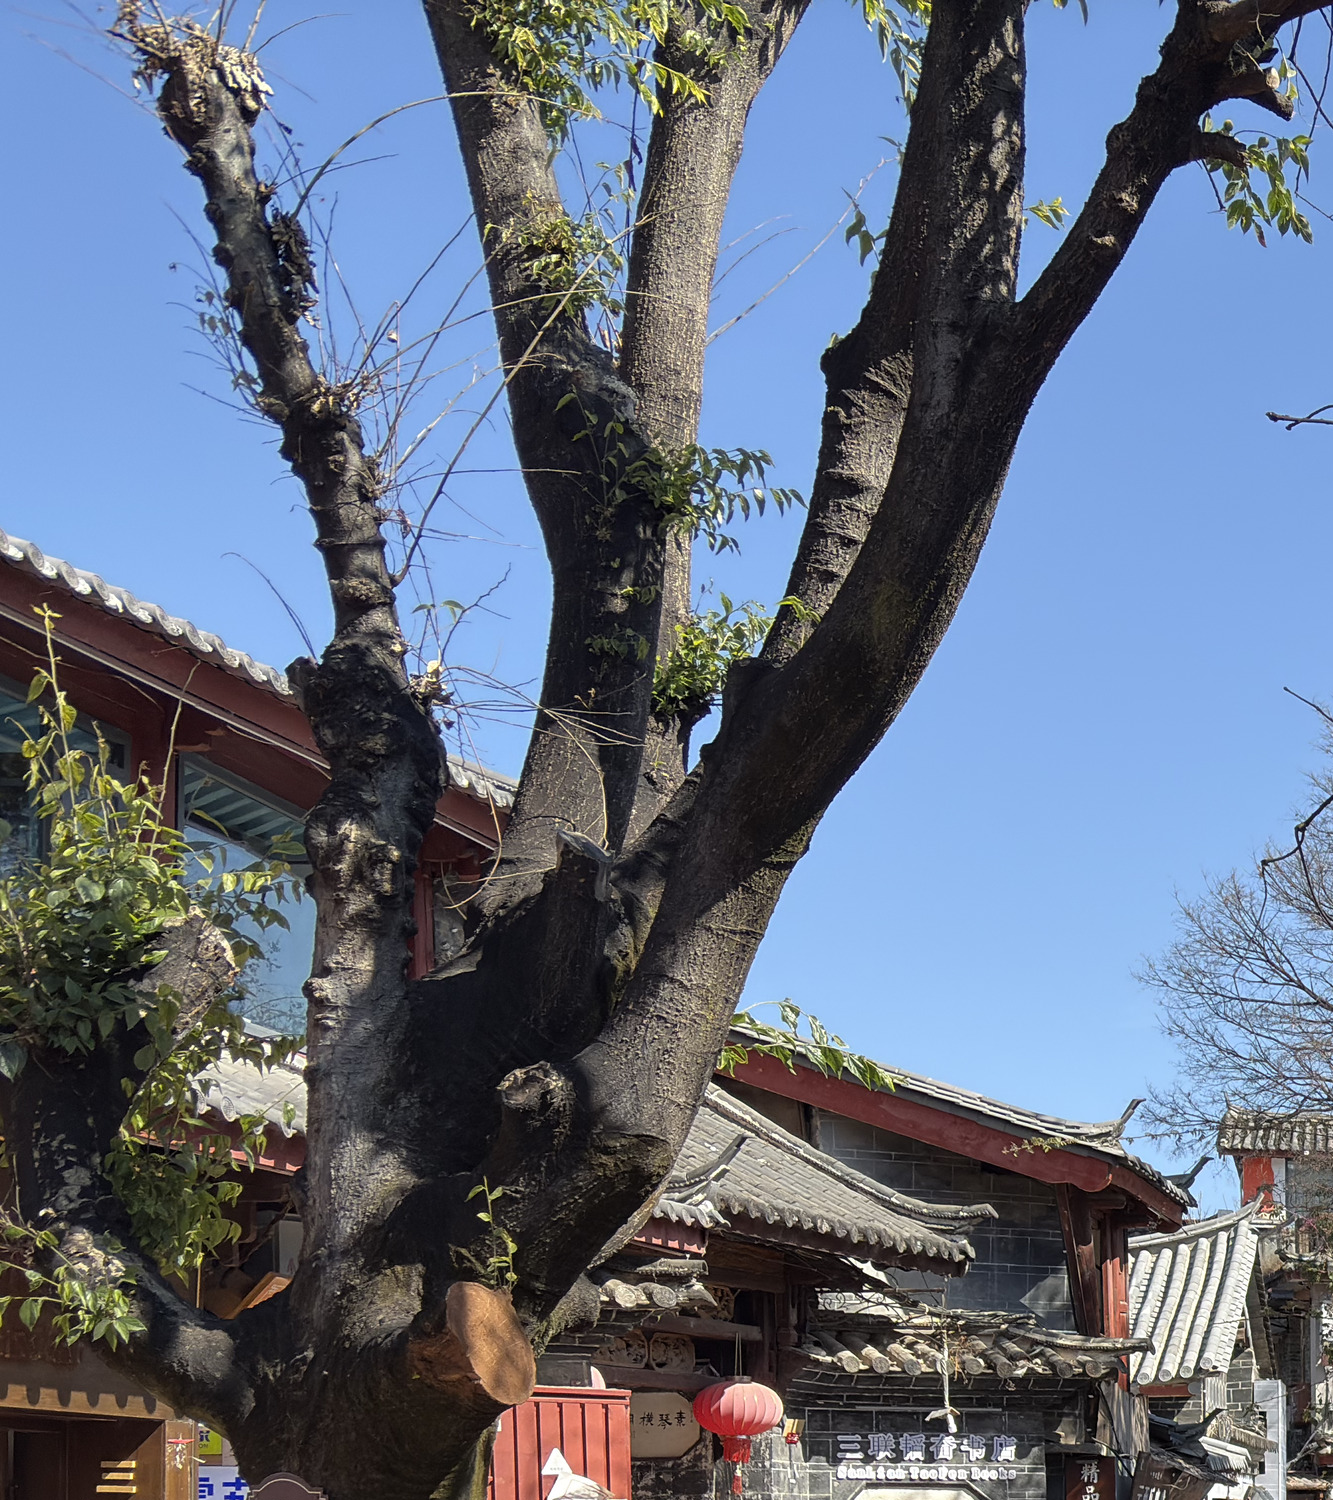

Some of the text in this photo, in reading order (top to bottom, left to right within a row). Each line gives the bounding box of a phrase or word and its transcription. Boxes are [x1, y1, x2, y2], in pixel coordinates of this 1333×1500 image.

[836, 1433, 1018, 1462] 三联韬奋书店
[971, 1465, 1017, 1481] Books
